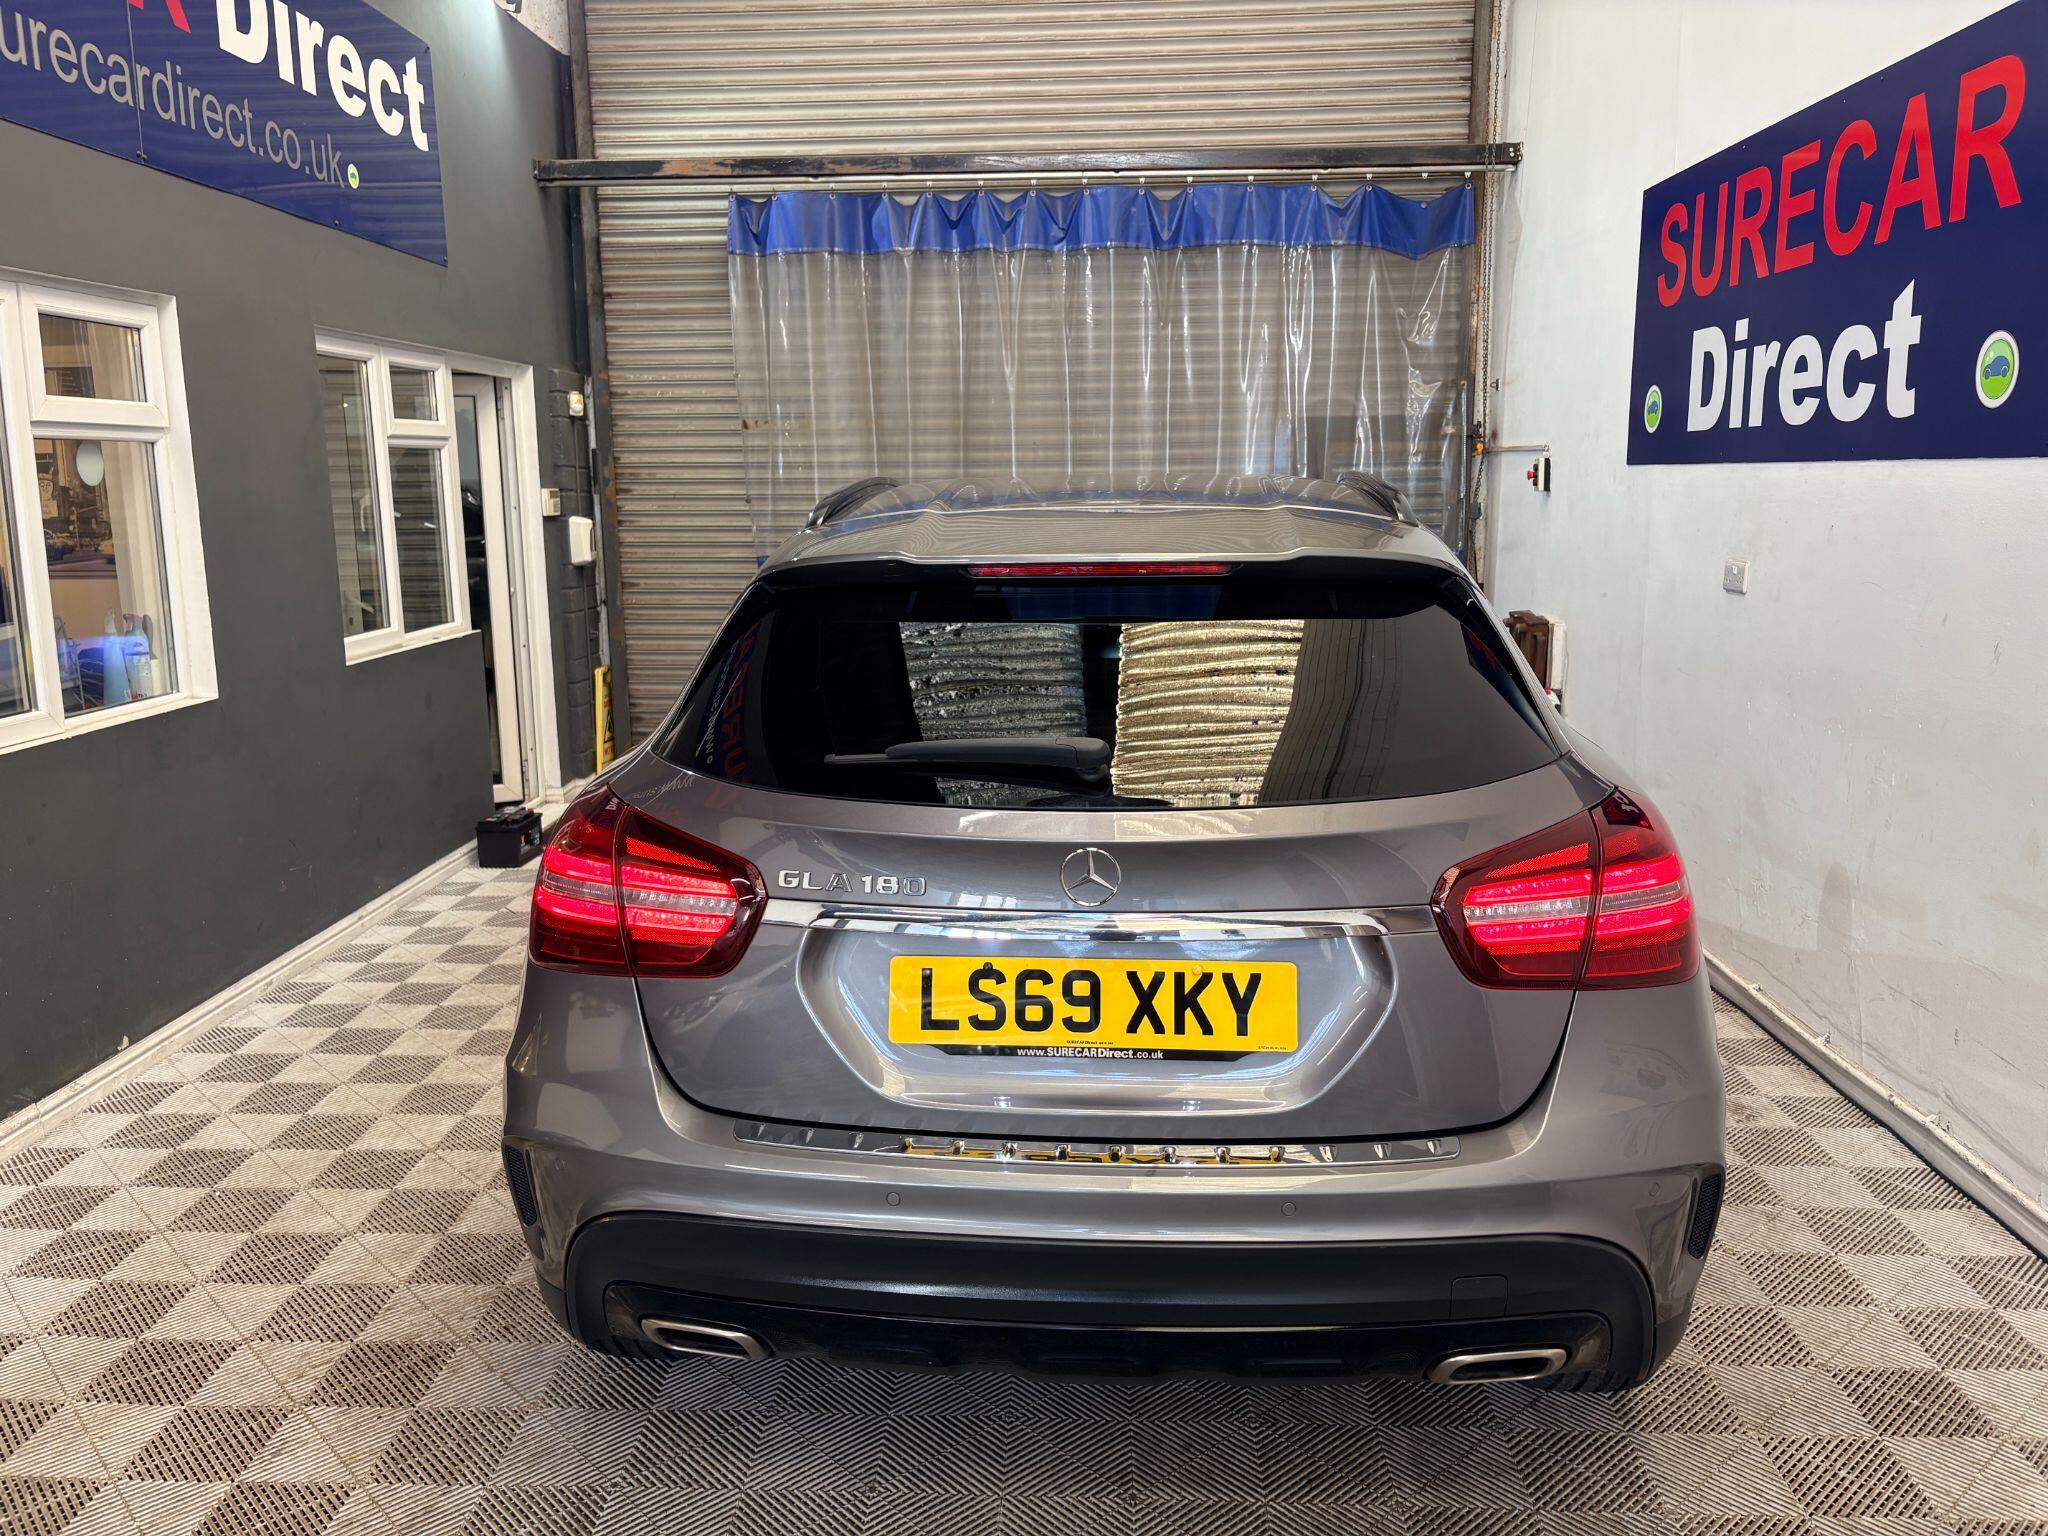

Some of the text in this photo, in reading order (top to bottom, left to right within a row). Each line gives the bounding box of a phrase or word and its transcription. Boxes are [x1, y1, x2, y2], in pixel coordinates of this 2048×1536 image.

[1657, 54, 2026, 307] SURECAR
[1687, 278, 1922, 432] Direct
[778, 869, 927, 896] GLA 180
[920, 966, 1262, 1036] LS69 XKY
[1017, 1047, 1163, 1059] www.SURECARDirect.co.uk
